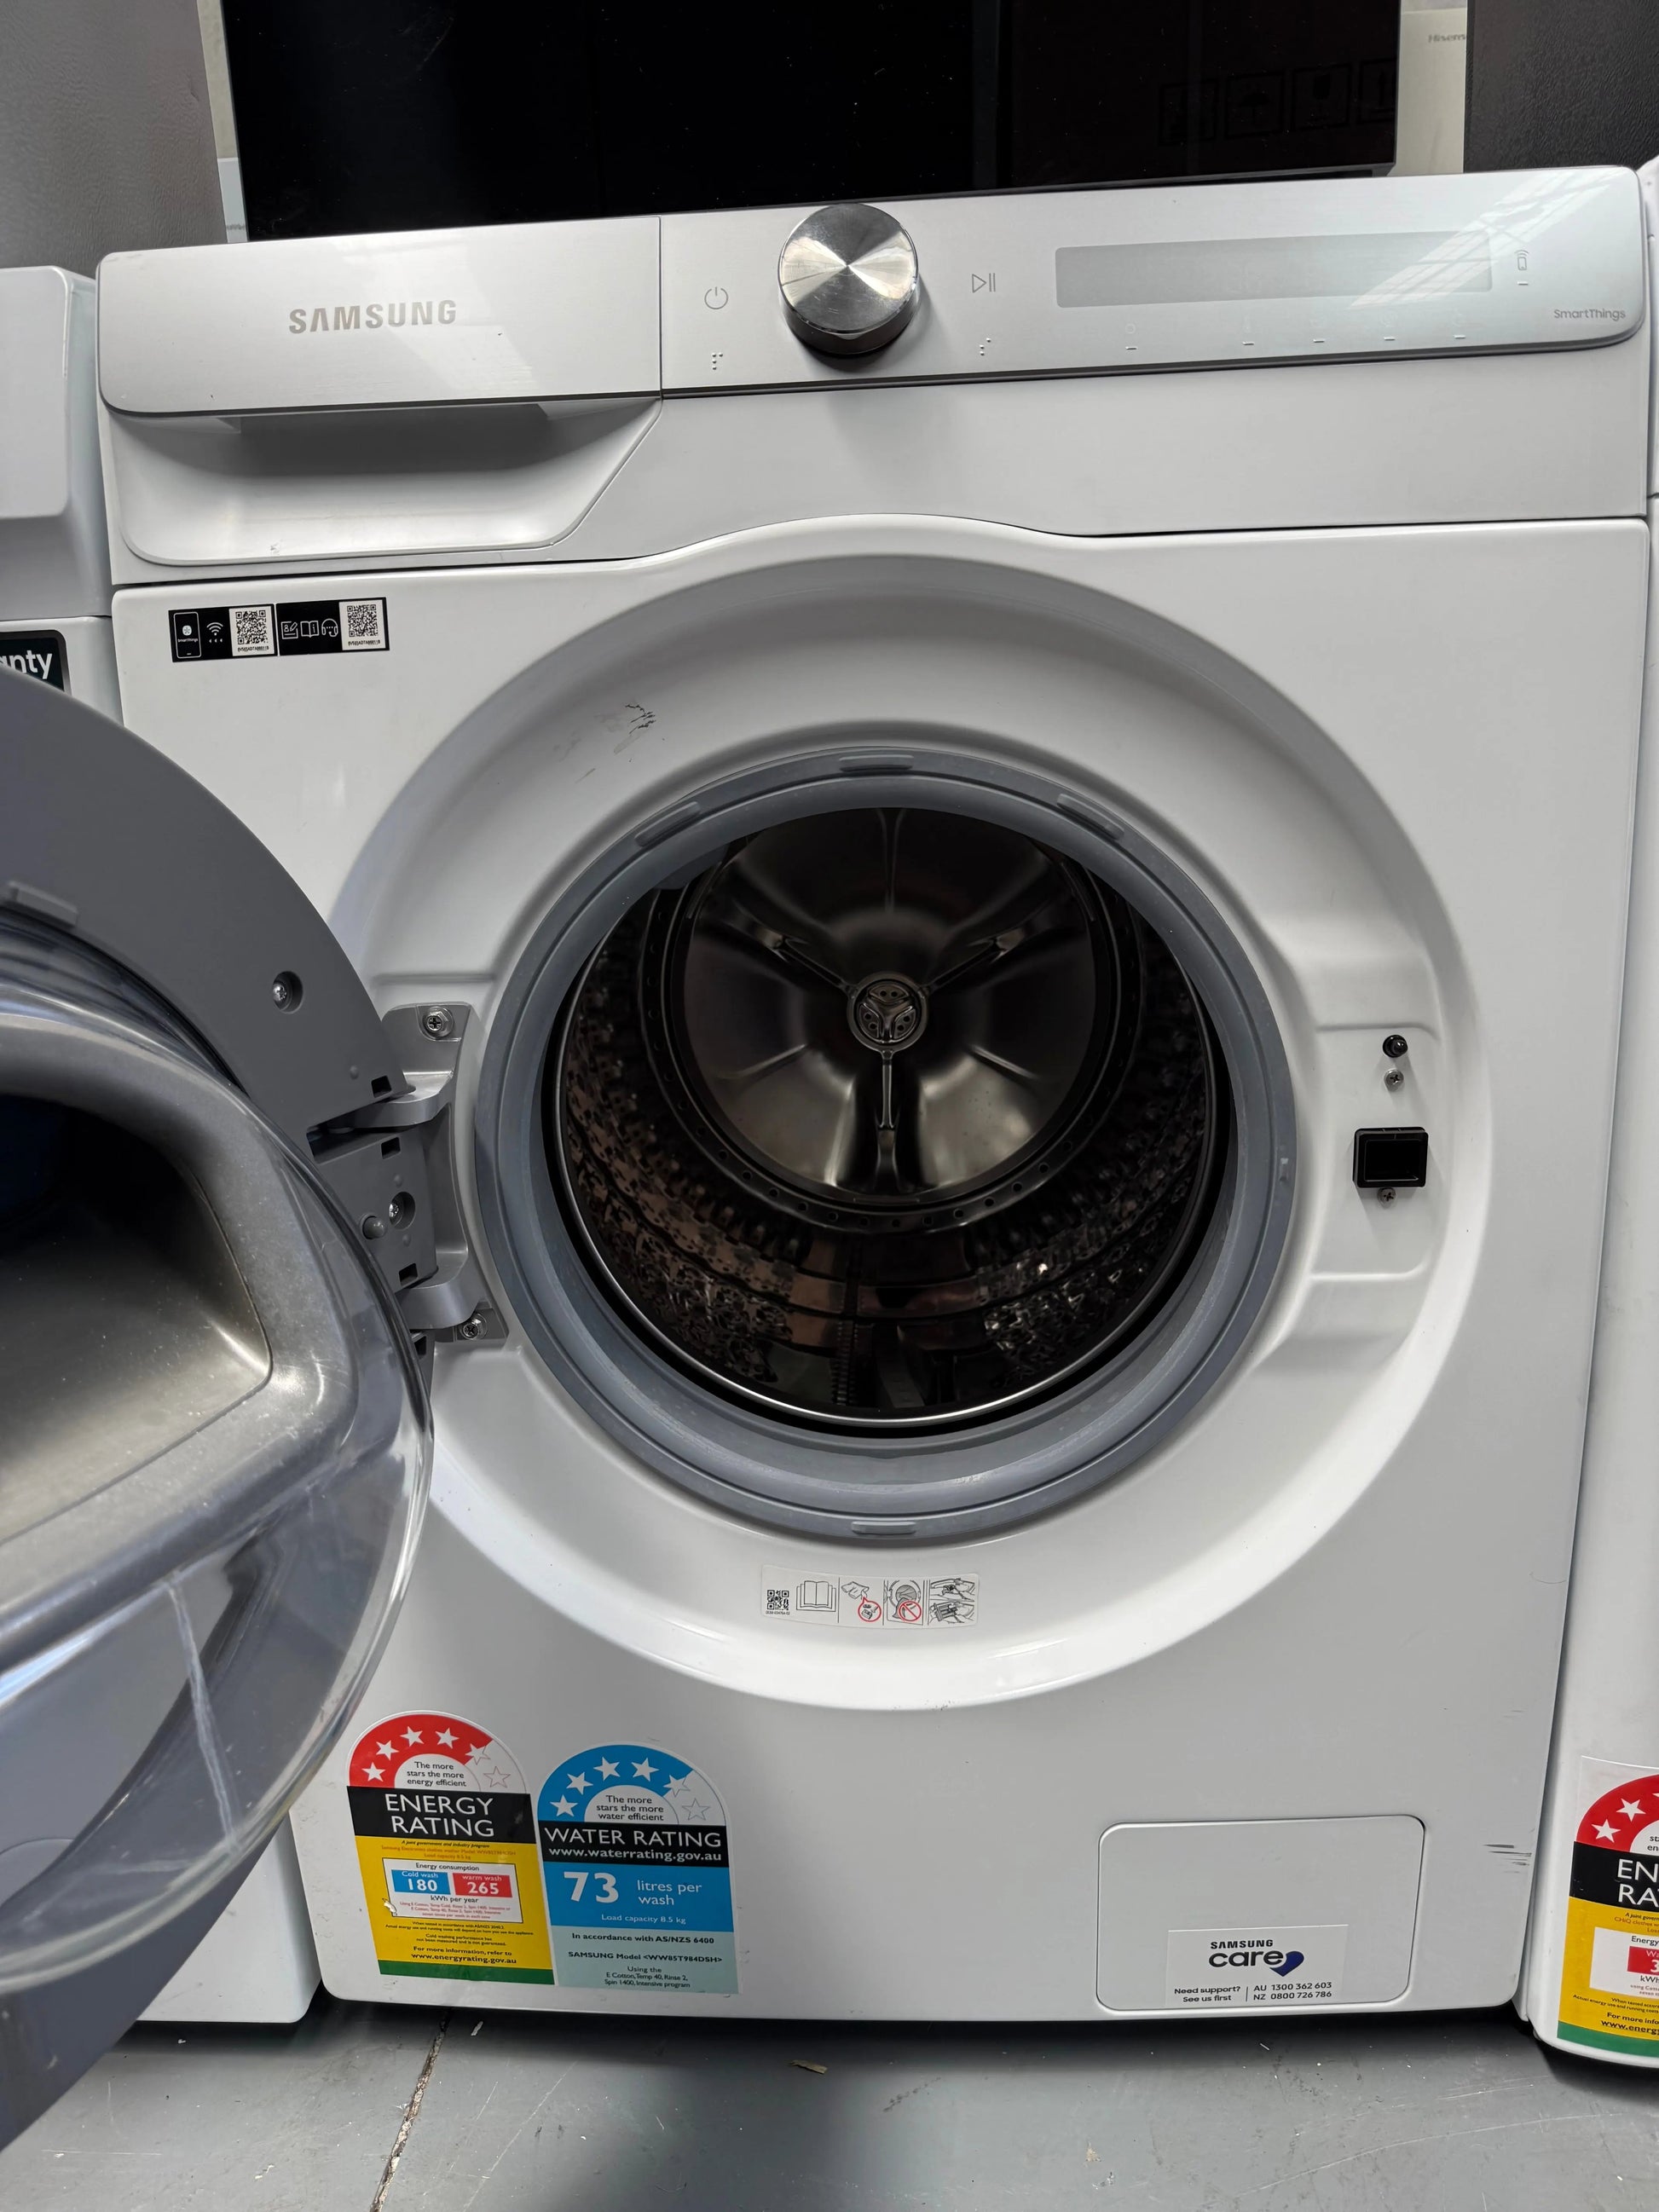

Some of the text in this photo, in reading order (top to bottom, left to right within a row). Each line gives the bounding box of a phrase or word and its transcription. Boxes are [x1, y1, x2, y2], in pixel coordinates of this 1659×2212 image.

[288, 299, 457, 334] SAMSUNG
[1553, 308, 1627, 322] SmartThings
[414, 1761, 431, 1770] The
[407, 1779, 467, 1788] energy efficient
[384, 1793, 494, 1816] ENERGY
[605, 1795, 625, 1804] The
[627, 1813, 664, 1822] efficient
[390, 1816, 494, 1837] RATING
[544, 1828, 722, 1848] WATER RATING
[548, 1848, 722, 1863] www.waterrating.gov.au
[408, 1878, 438, 1891] 180
[466, 1881, 500, 1895] 265
[564, 1871, 620, 1903] 73
[636, 1880, 702, 1894] litres per
[638, 1894, 675, 1905] wash
[1618, 1883, 1659, 1908] RA
[624, 1915, 659, 1924] capacity
[675, 1916, 686, 1925] kg
[1210, 1939, 1274, 1949] SAMSUNG
[1631, 1935, 1659, 1947] Energy
[411, 1954, 517, 1964] www.energyrating.gov.au
[1208, 1949, 1284, 1967] care
[1199, 1986, 1241, 1995] support?
[1600, 2019, 1659, 2036] www.energ
